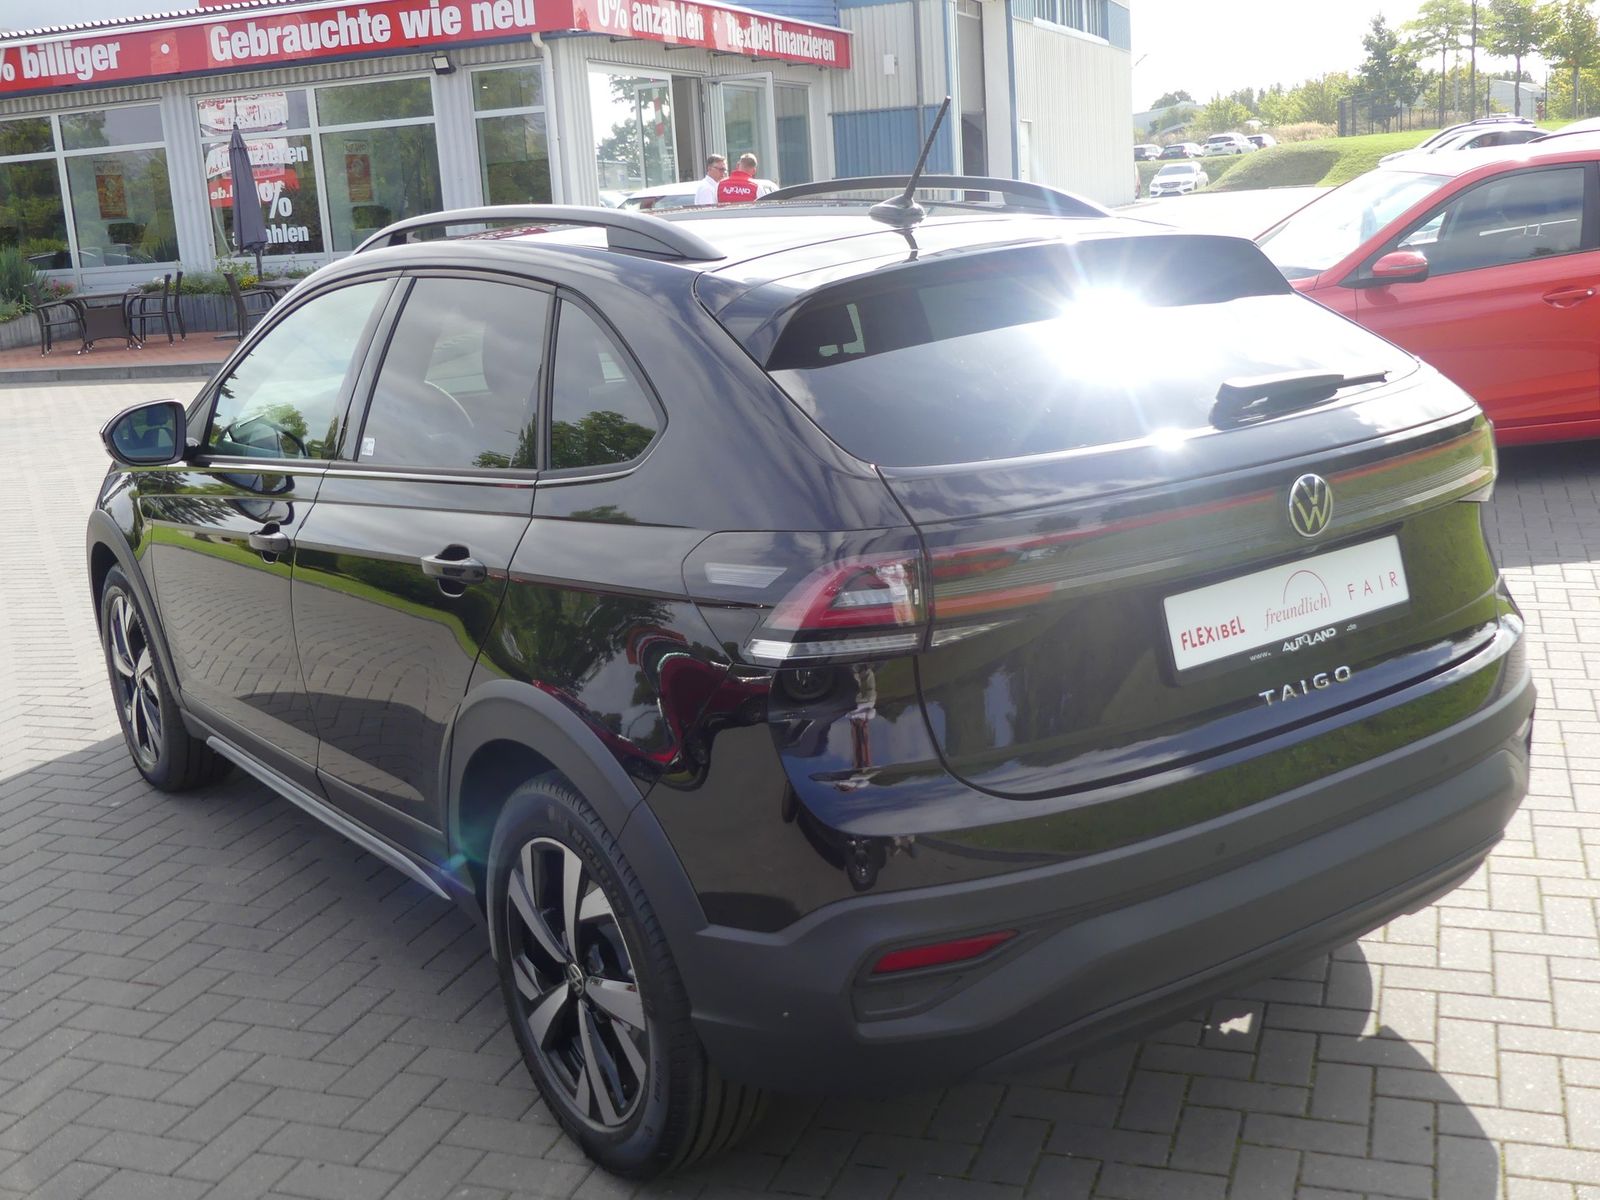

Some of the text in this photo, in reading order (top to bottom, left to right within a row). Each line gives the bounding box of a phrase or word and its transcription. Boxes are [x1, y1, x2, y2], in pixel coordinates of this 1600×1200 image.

[210, 0, 536, 61] Gebrauchte wie neu
[597, 0, 705, 41] 0% anzahlen
[726, 12, 836, 62] flexibel finanzieren
[20, 40, 121, 81] billiger
[1180, 570, 1399, 651] FLEXIBEL freundlich FAIR
[1282, 627, 1337, 652] AUTOLAND
[1258, 665, 1352, 706] TAIGO
